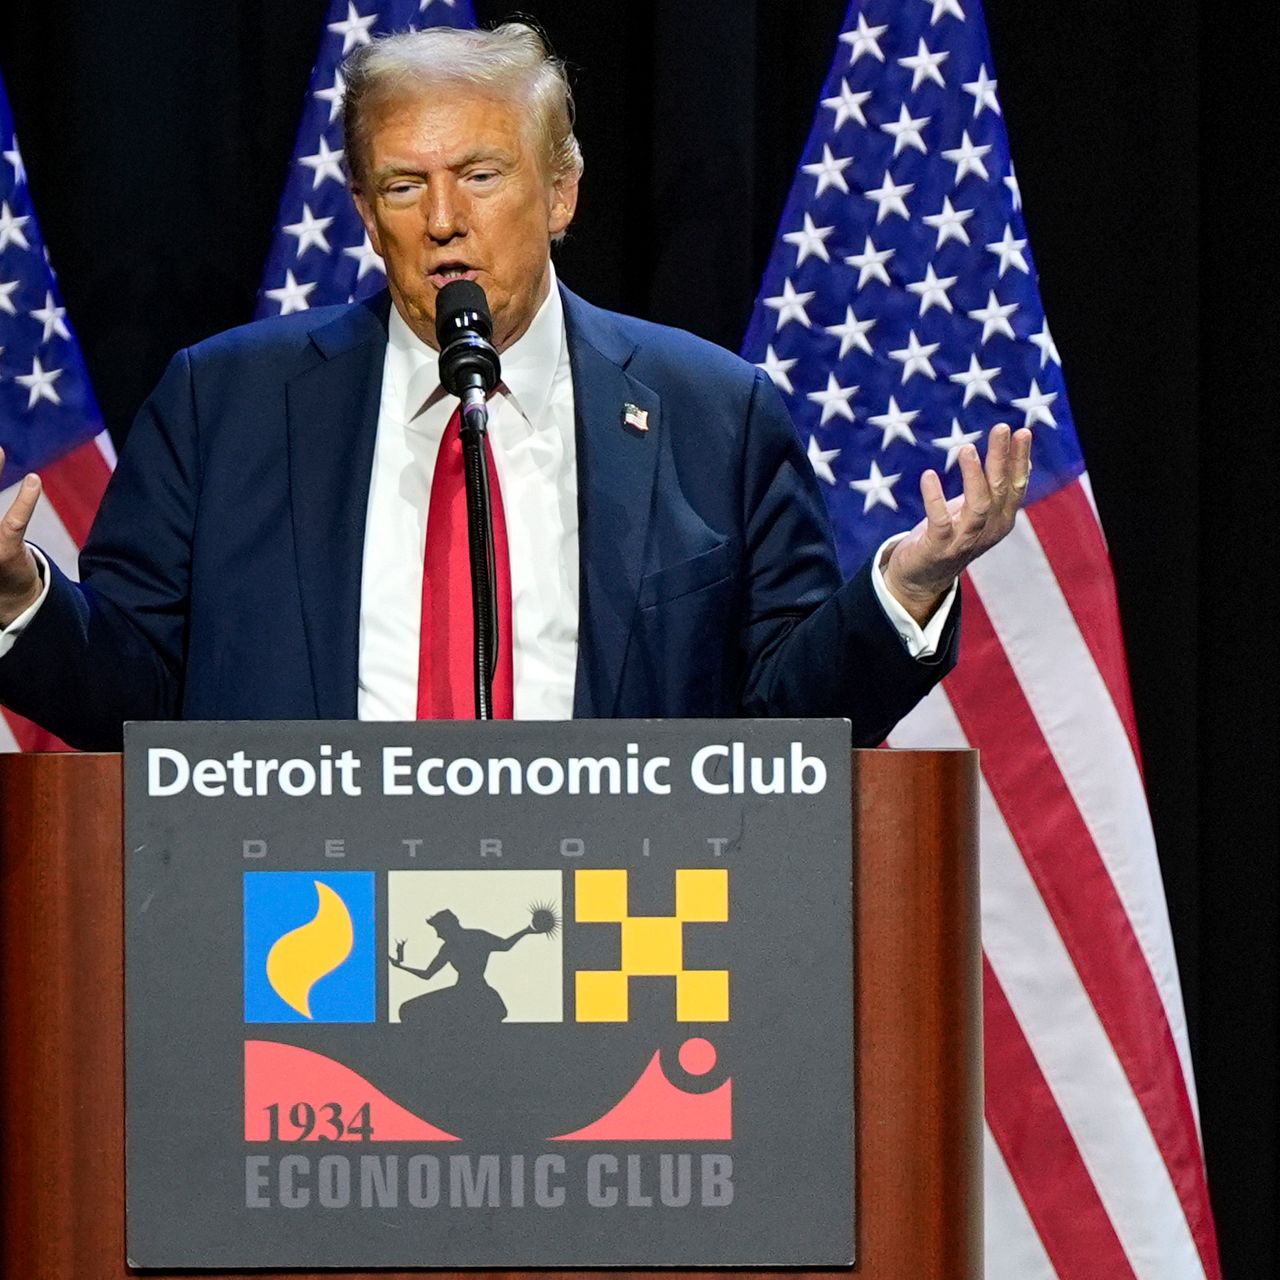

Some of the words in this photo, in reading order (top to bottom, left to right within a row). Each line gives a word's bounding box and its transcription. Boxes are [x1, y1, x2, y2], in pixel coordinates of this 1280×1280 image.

[147, 745, 362, 797] Detroit
[381, 742, 672, 795] Economic
[690, 740, 829, 795] Club
[242, 837, 732, 859] DETROIT
[262, 1101, 375, 1142] 1934
[244, 1154, 567, 1209] ECONOMIC
[586, 1152, 736, 1208] CLUB
